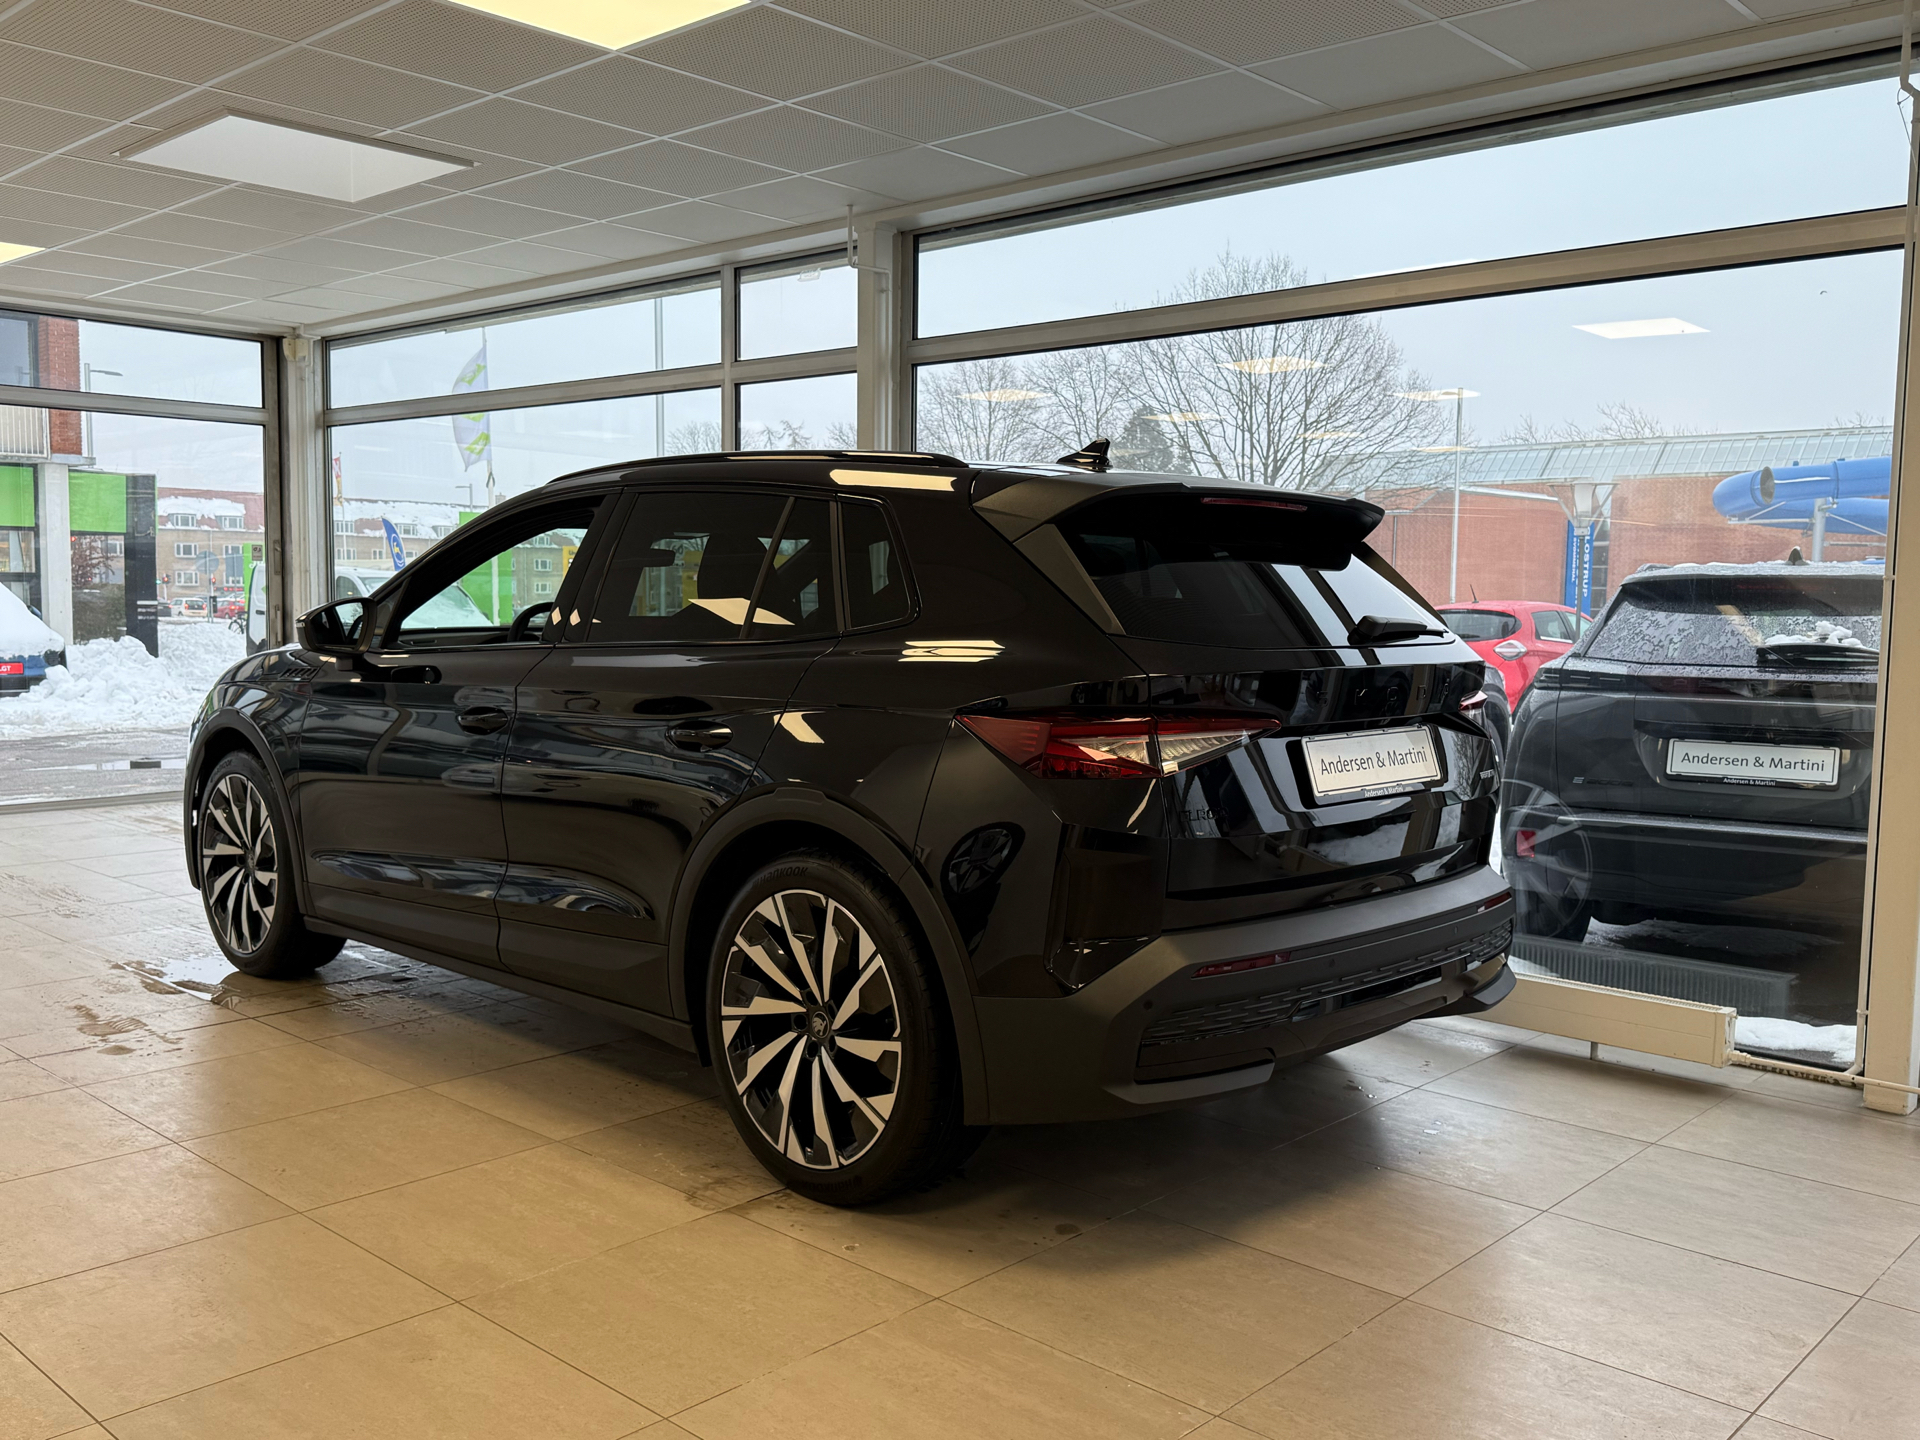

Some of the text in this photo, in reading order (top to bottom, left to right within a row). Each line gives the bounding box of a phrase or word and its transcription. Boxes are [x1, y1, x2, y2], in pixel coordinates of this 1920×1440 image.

[1321, 746, 1428, 776] Andersen & Martini
[1681, 752, 1825, 772] Andersen & Martini
[1723, 777, 1749, 785] Andersen
[1755, 779, 1776, 787] Martini
[1364, 788, 1382, 798] Andersen
[1388, 784, 1404, 794] Martini
